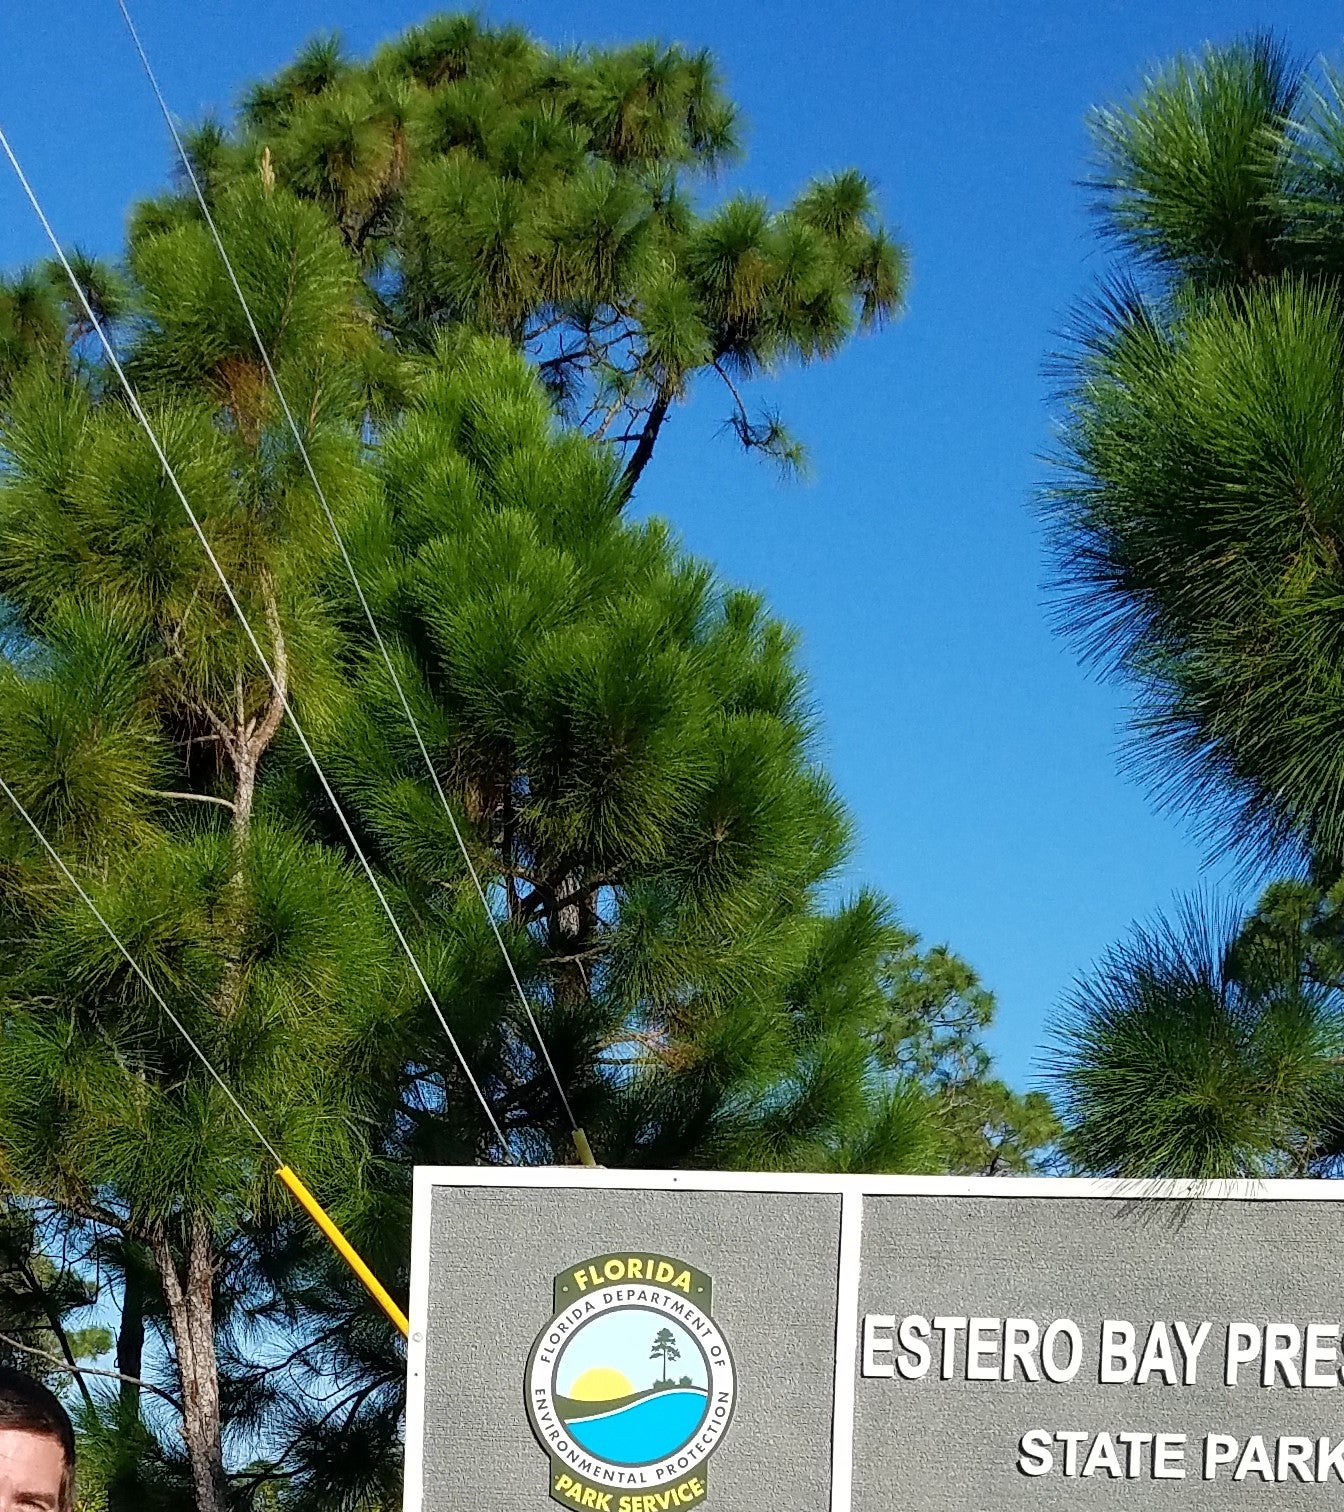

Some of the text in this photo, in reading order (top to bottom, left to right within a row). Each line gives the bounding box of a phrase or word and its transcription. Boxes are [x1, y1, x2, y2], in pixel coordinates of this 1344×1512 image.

[573, 1258, 692, 1293] FLORIDA
[540, 1289, 726, 1367] FLORIDA DEPARTMENT OF
[862, 1314, 1083, 1383] ESTERO
[1098, 1319, 1213, 1385] BAY
[534, 1388, 730, 1484] ENVIRONMENTAL PROTECTION
[1017, 1428, 1187, 1480] STATE
[554, 1473, 613, 1512] PARK
